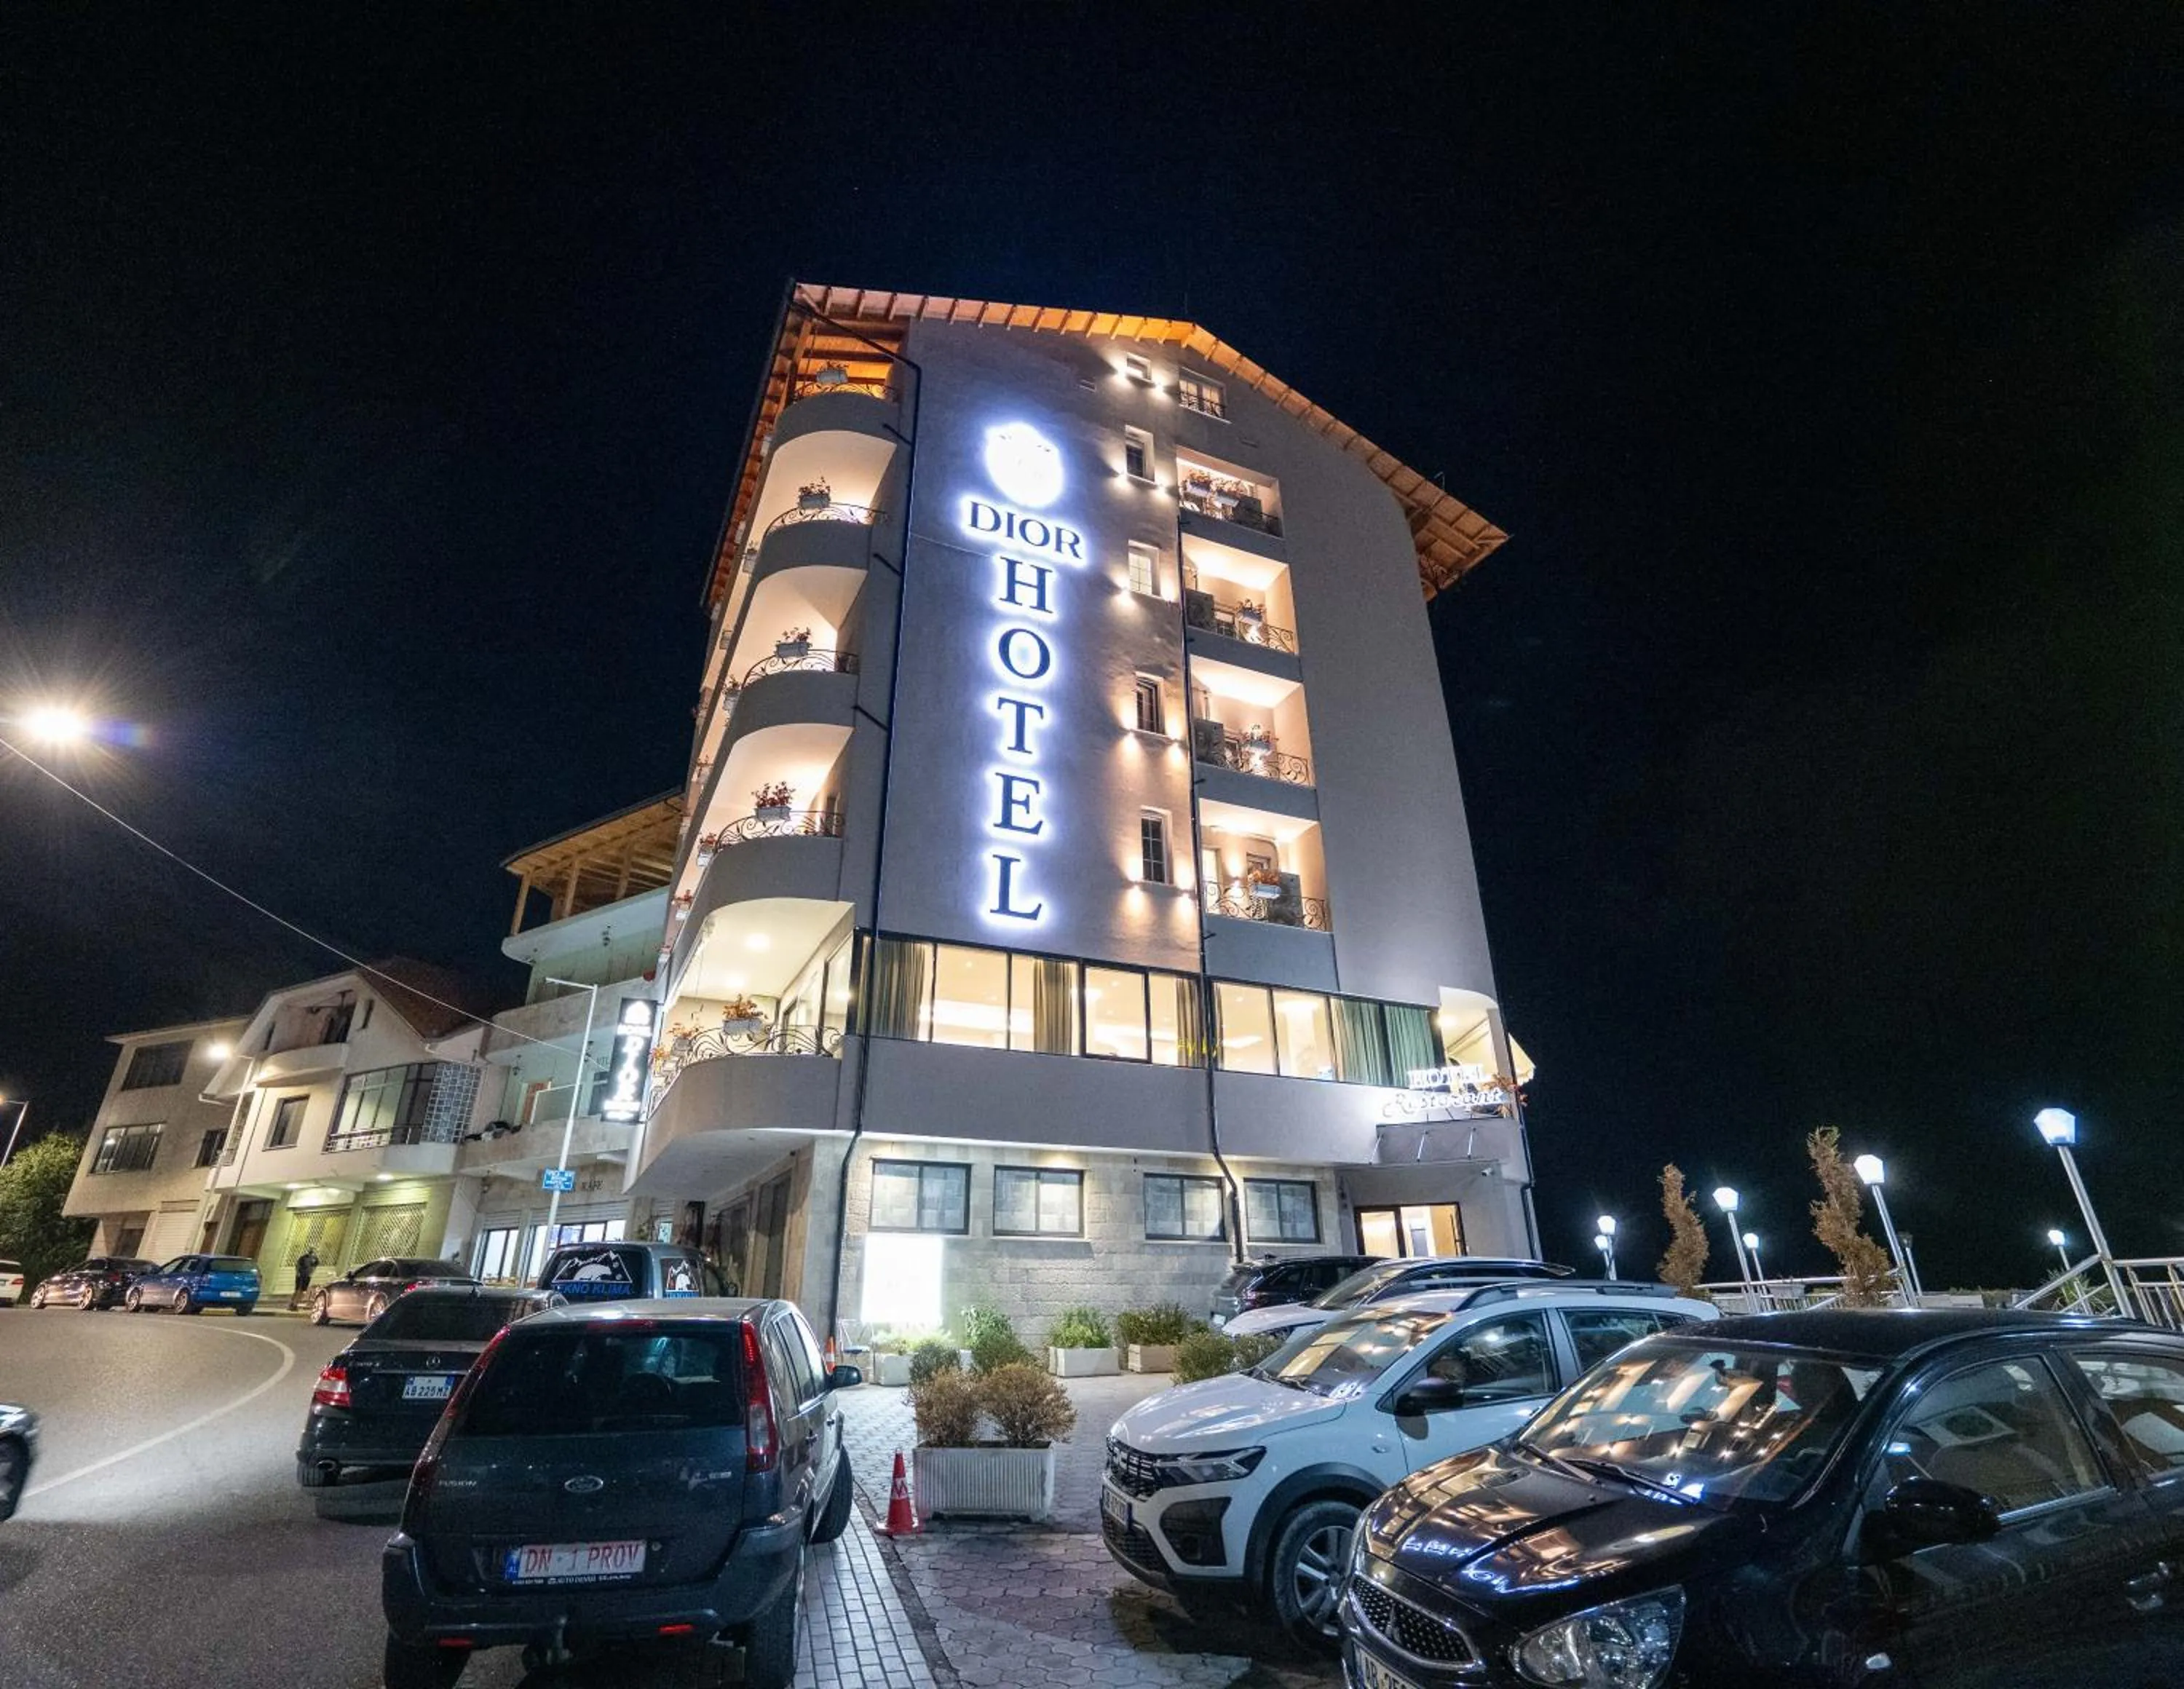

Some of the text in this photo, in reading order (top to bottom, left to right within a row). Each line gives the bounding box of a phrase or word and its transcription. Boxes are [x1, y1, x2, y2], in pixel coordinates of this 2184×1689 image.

[968, 500, 1083, 560] DIOR
[989, 556, 1053, 921] HOTEL
[438, 1479, 478, 1487] FUSION
[524, 1548, 553, 1573] DN
[587, 1544, 639, 1570] PROV
